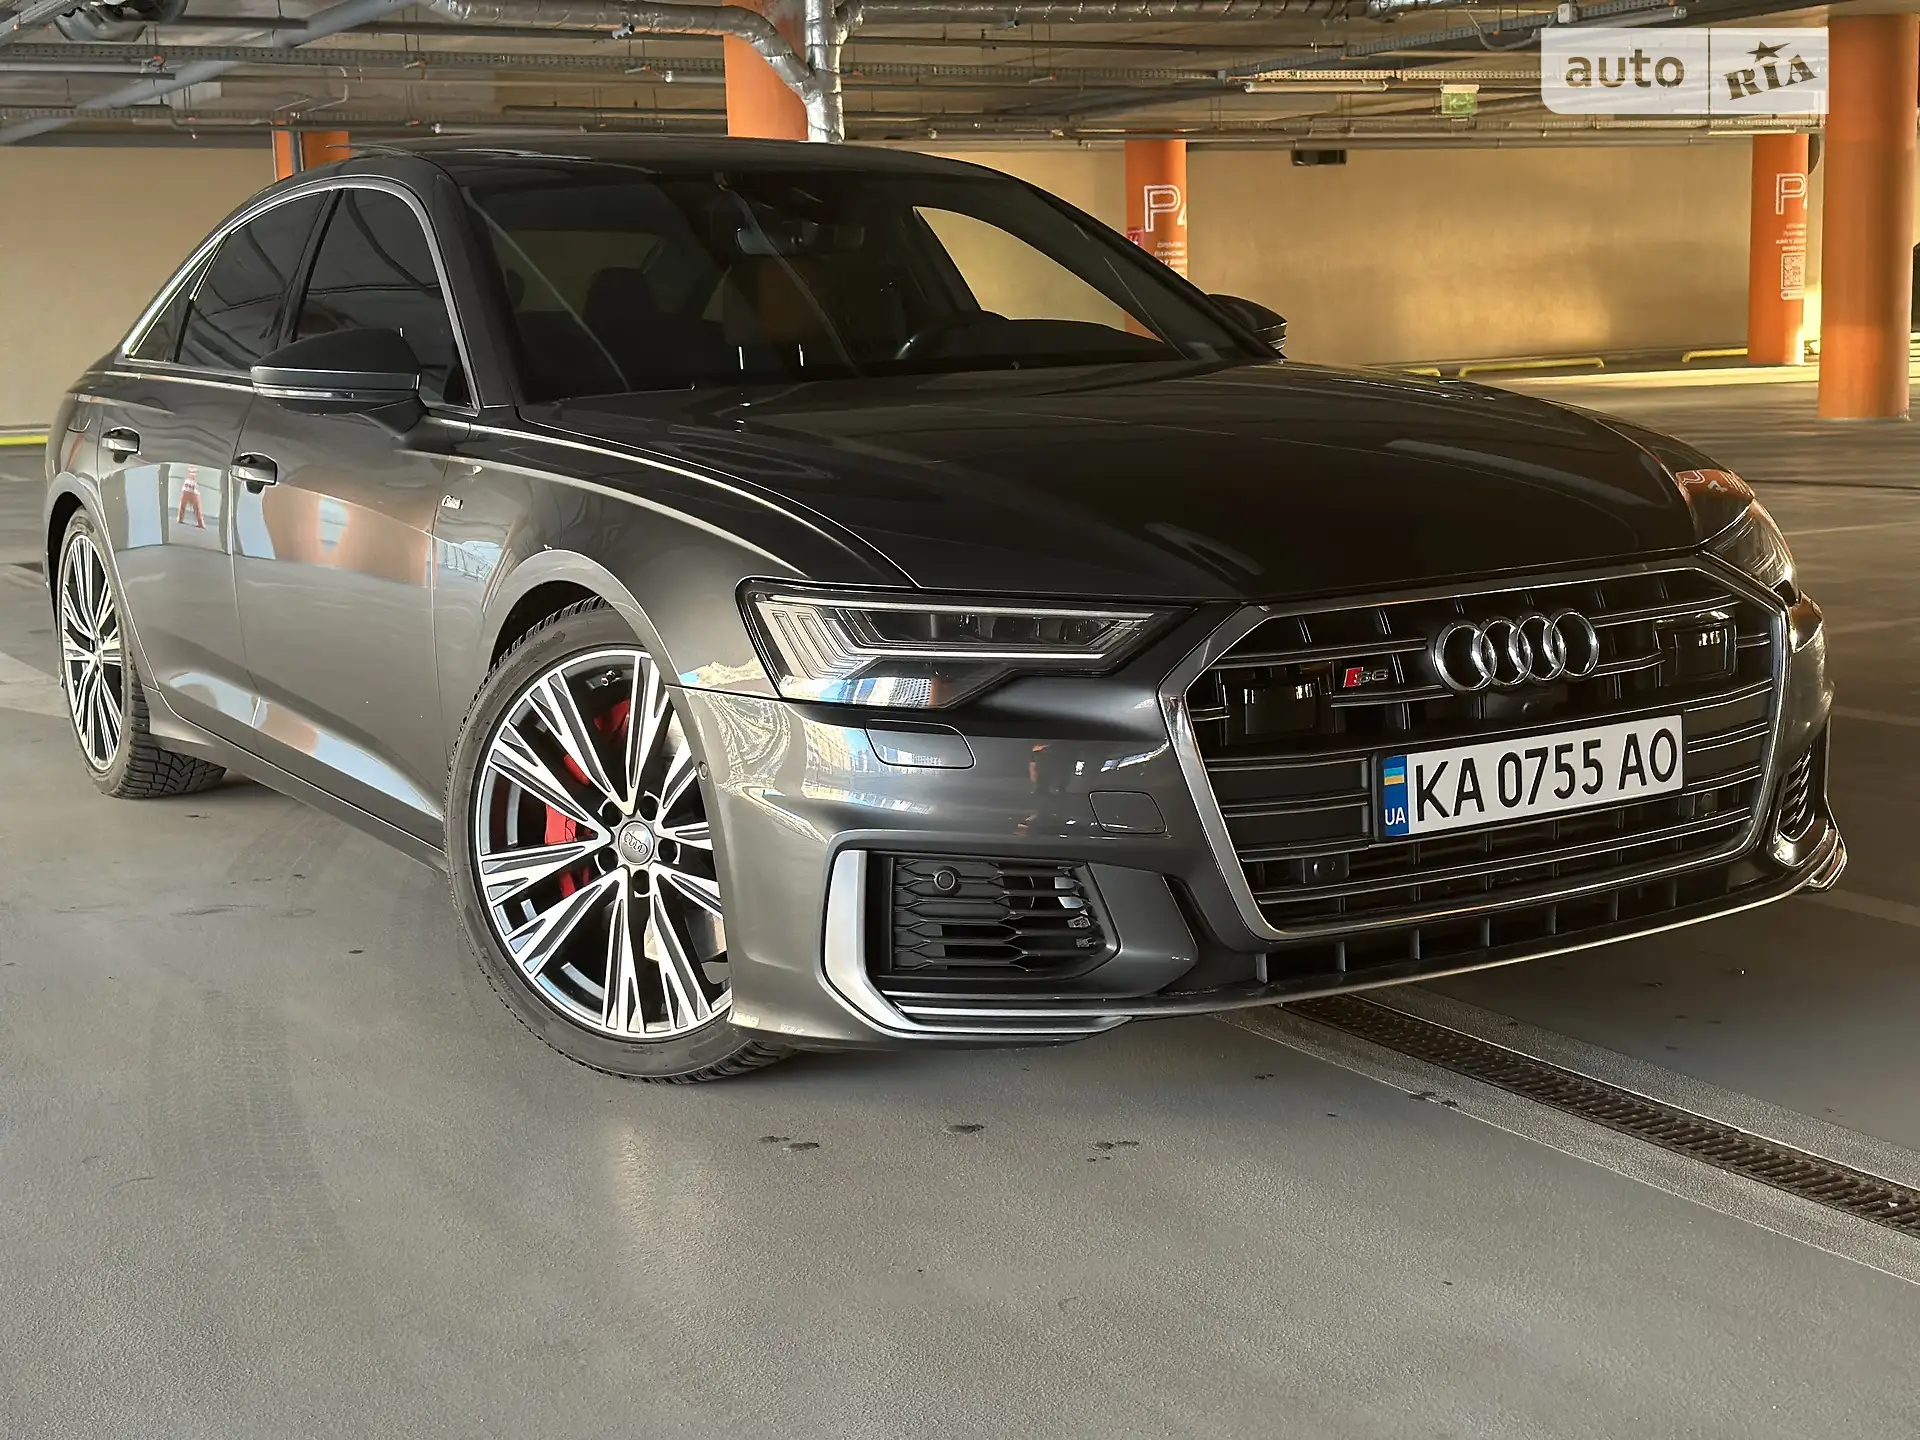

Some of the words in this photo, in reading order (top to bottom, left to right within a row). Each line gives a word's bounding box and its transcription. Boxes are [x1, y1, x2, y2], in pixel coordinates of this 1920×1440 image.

[1776, 173, 1807, 215] P
[1415, 757, 1485, 822] KA
[1498, 738, 1603, 808] 0755
[1618, 728, 1677, 790] AO
[1384, 806, 1406, 826] UA
